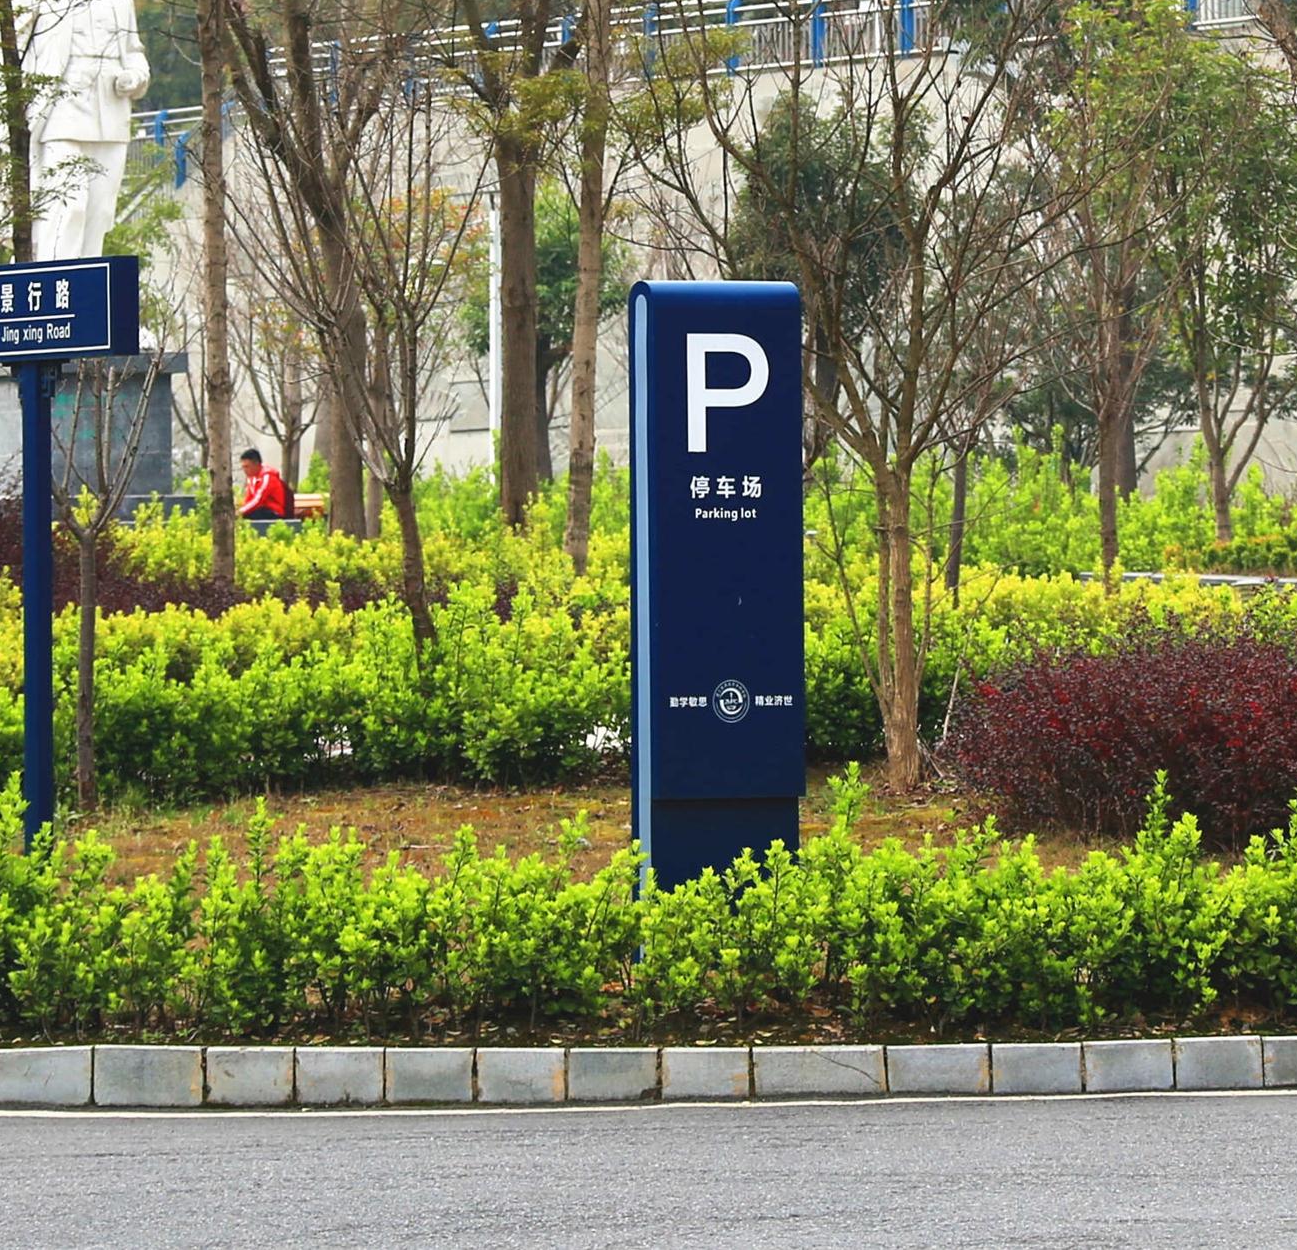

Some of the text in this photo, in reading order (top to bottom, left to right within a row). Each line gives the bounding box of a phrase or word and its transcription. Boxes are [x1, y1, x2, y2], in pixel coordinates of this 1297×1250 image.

[0, 278, 70, 313] 景行路
[1, 322, 71, 345] Jing xing Road
[686, 333, 770, 452] P
[689, 475, 762, 499] 停车场
[695, 507, 757, 522] Parking lot
